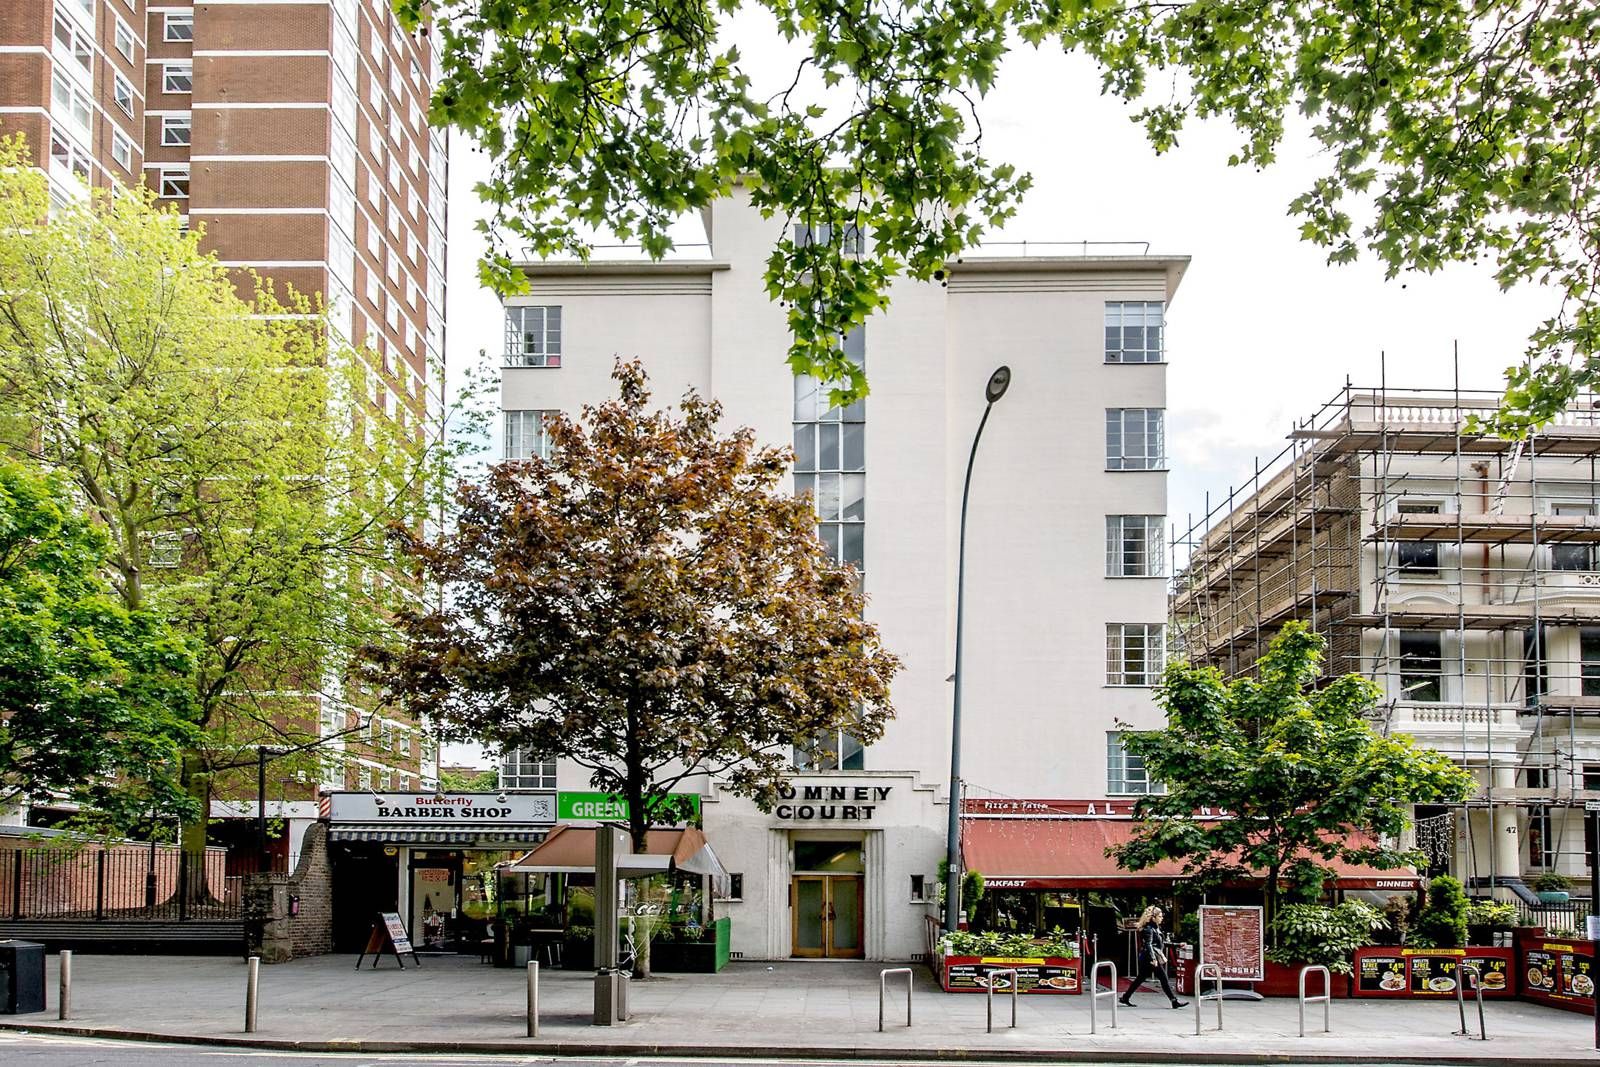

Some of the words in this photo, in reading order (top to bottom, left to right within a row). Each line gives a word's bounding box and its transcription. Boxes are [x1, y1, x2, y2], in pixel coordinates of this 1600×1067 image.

[778, 786, 893, 801] OMNEY
[416, 797, 472, 806] Butterfly
[378, 807, 459, 818] BARBER
[461, 807, 512, 818] SHOP
[572, 802, 626, 817] GREEN
[776, 805, 876, 819] COURT
[1376, 880, 1414, 888] DINNER
